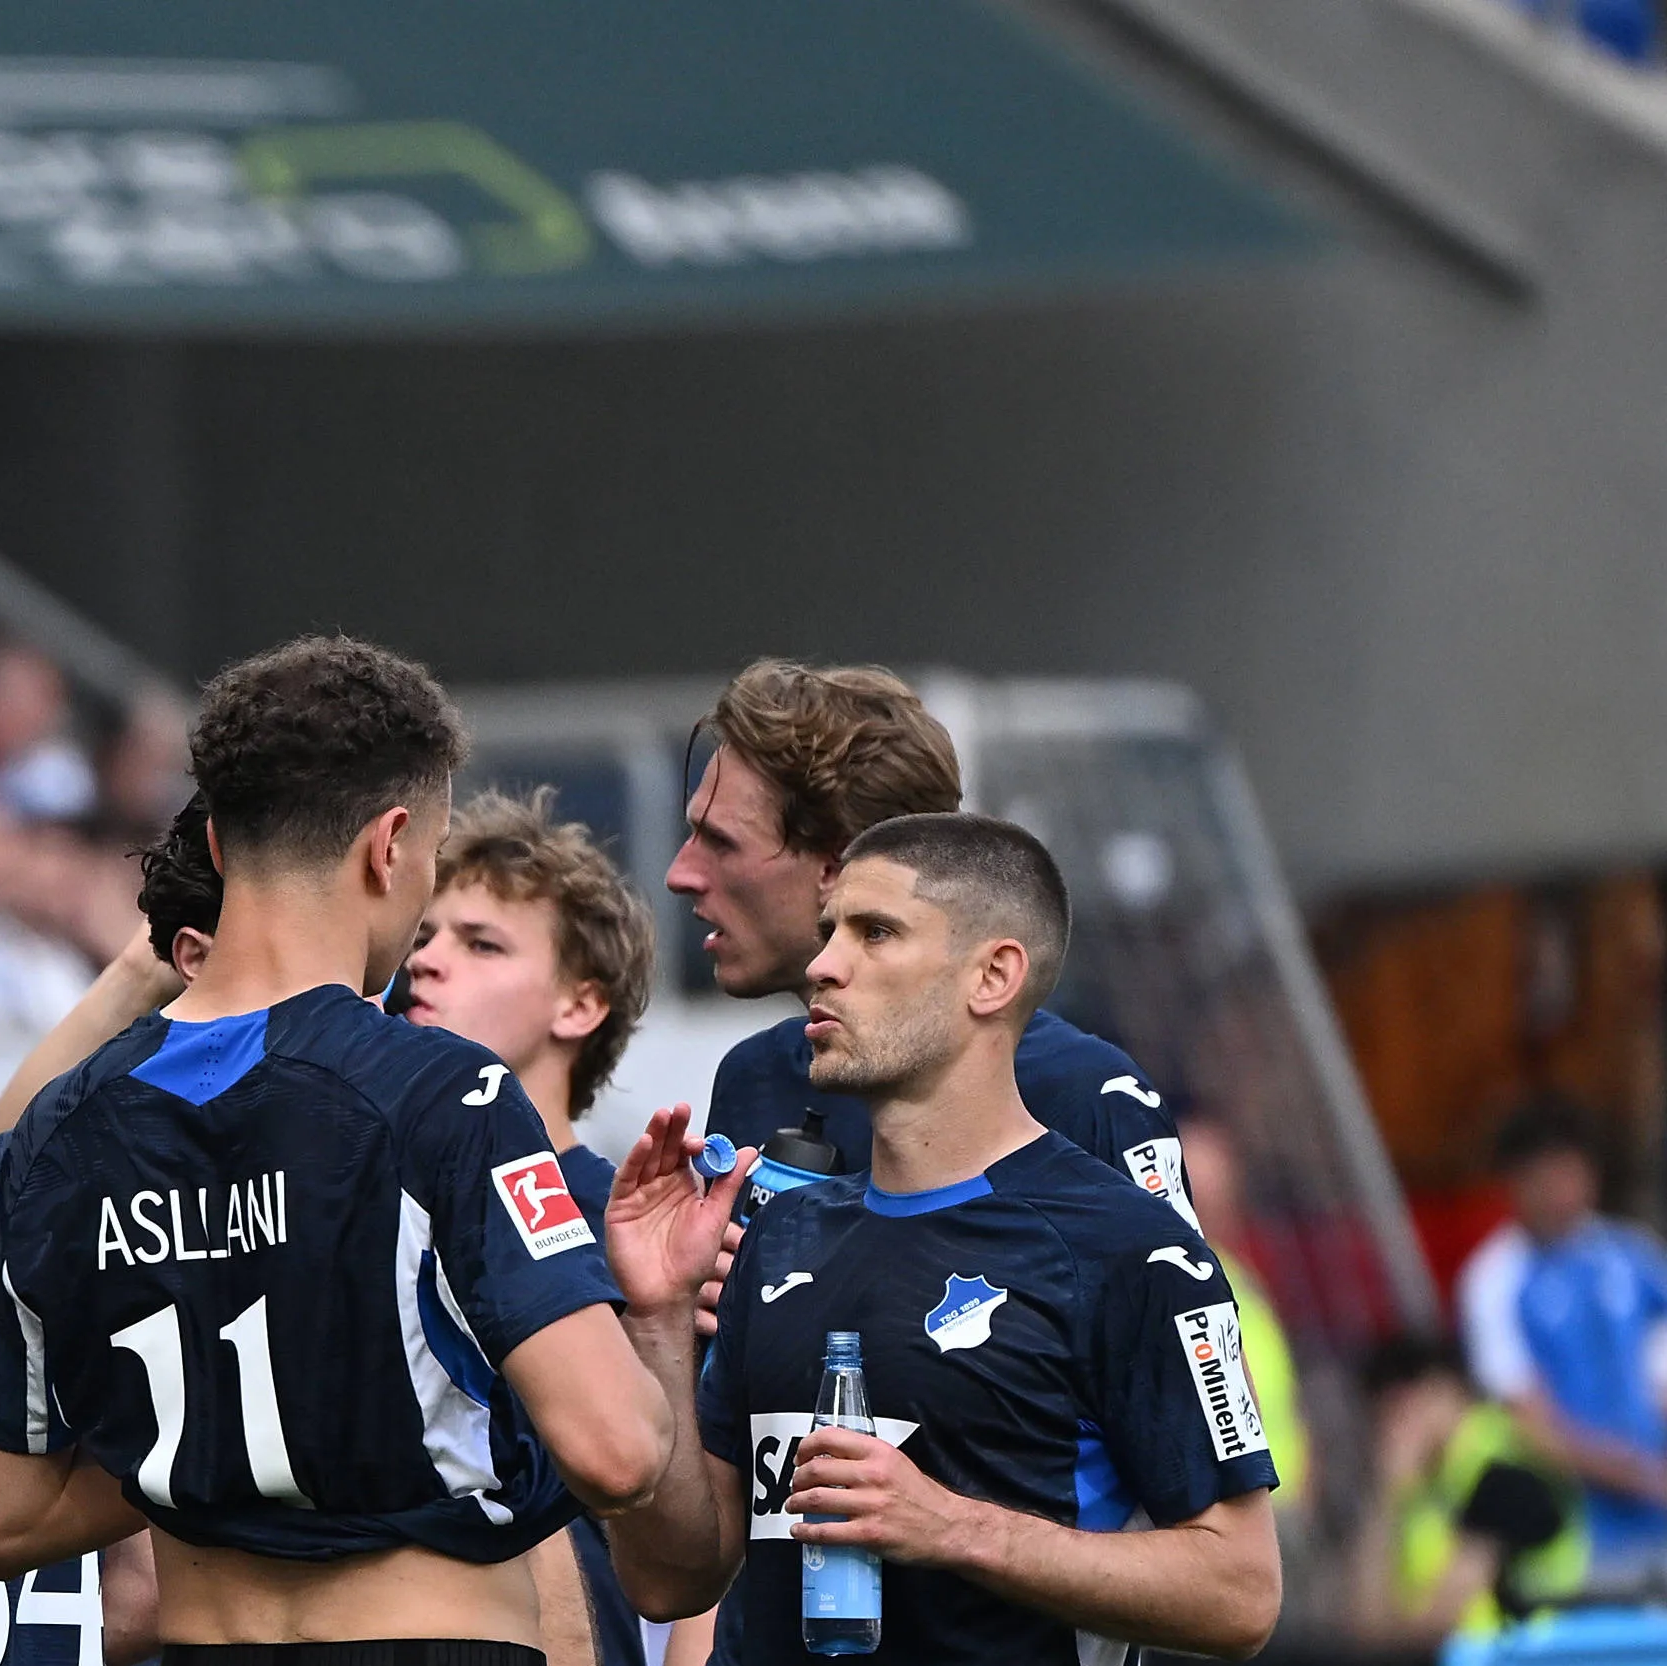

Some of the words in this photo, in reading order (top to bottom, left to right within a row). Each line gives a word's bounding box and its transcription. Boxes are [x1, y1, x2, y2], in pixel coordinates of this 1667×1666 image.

[98, 1170, 287, 1270] ASLLANI
[939, 1309, 959, 1325] TSG
[960, 1297, 981, 1312] 1899
[110, 1294, 316, 1510] 11
[1184, 1311, 1246, 1456] ProMinent
